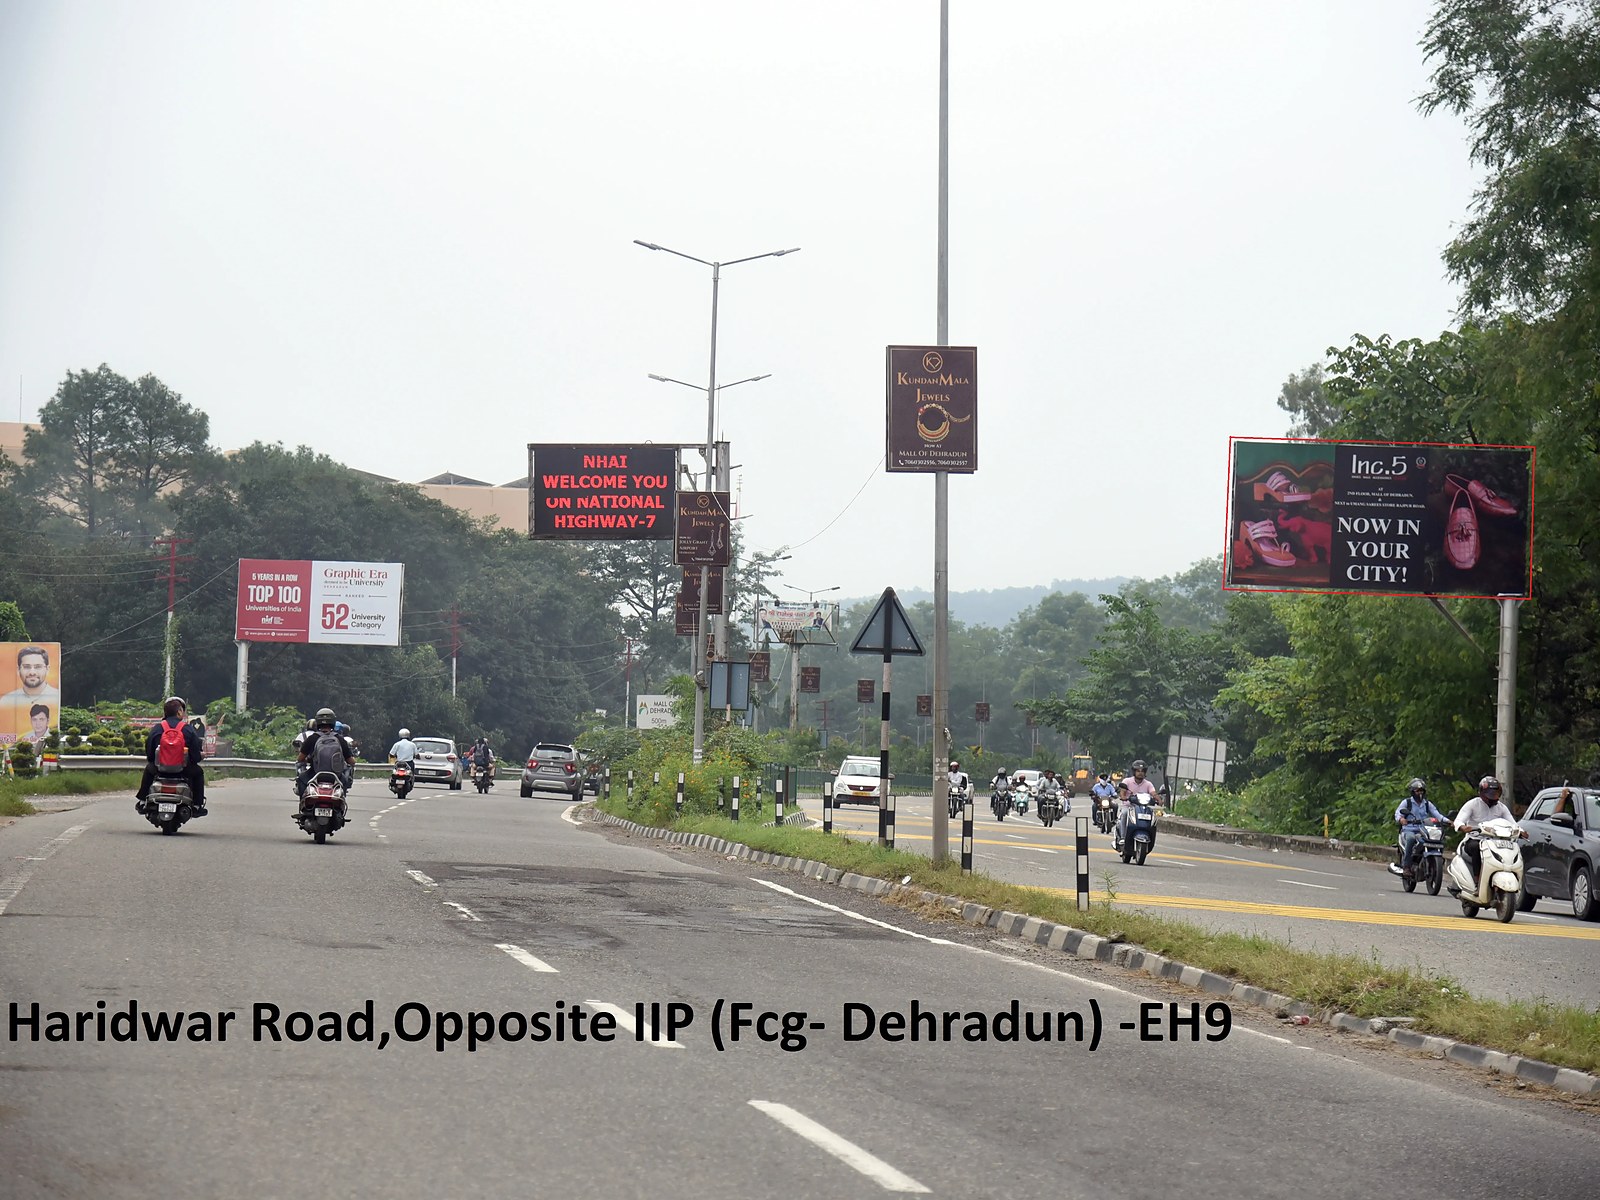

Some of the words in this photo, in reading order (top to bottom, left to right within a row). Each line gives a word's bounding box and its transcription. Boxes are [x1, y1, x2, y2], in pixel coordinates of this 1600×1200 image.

[916, 388, 950, 403] JEWELS
[583, 455, 628, 469] NHAI
[1352, 454, 1408, 475] Inc.5
[543, 475, 627, 489] WELCOME
[632, 475, 668, 489] YOU
[546, 497, 571, 509] ON
[577, 495, 665, 509] NATIONAL
[554, 514, 656, 528] HIGHWAY-7
[1337, 517, 1391, 535] NOW
[1397, 519, 1421, 536] IN
[1346, 541, 1410, 560] YOUR
[252, 573, 256, 581] 5
[257, 573, 274, 581] YEARS
[286, 574, 298, 582] ROW
[324, 568, 366, 580] Graphic
[369, 569, 388, 579] Era
[1346, 564, 1407, 583] CITY!
[349, 579, 385, 587] University
[248, 585, 274, 603] TOP
[278, 586, 301, 604] 100
[321, 603, 349, 630] 52
[351, 613, 386, 622] University
[351, 621, 382, 629] Category
